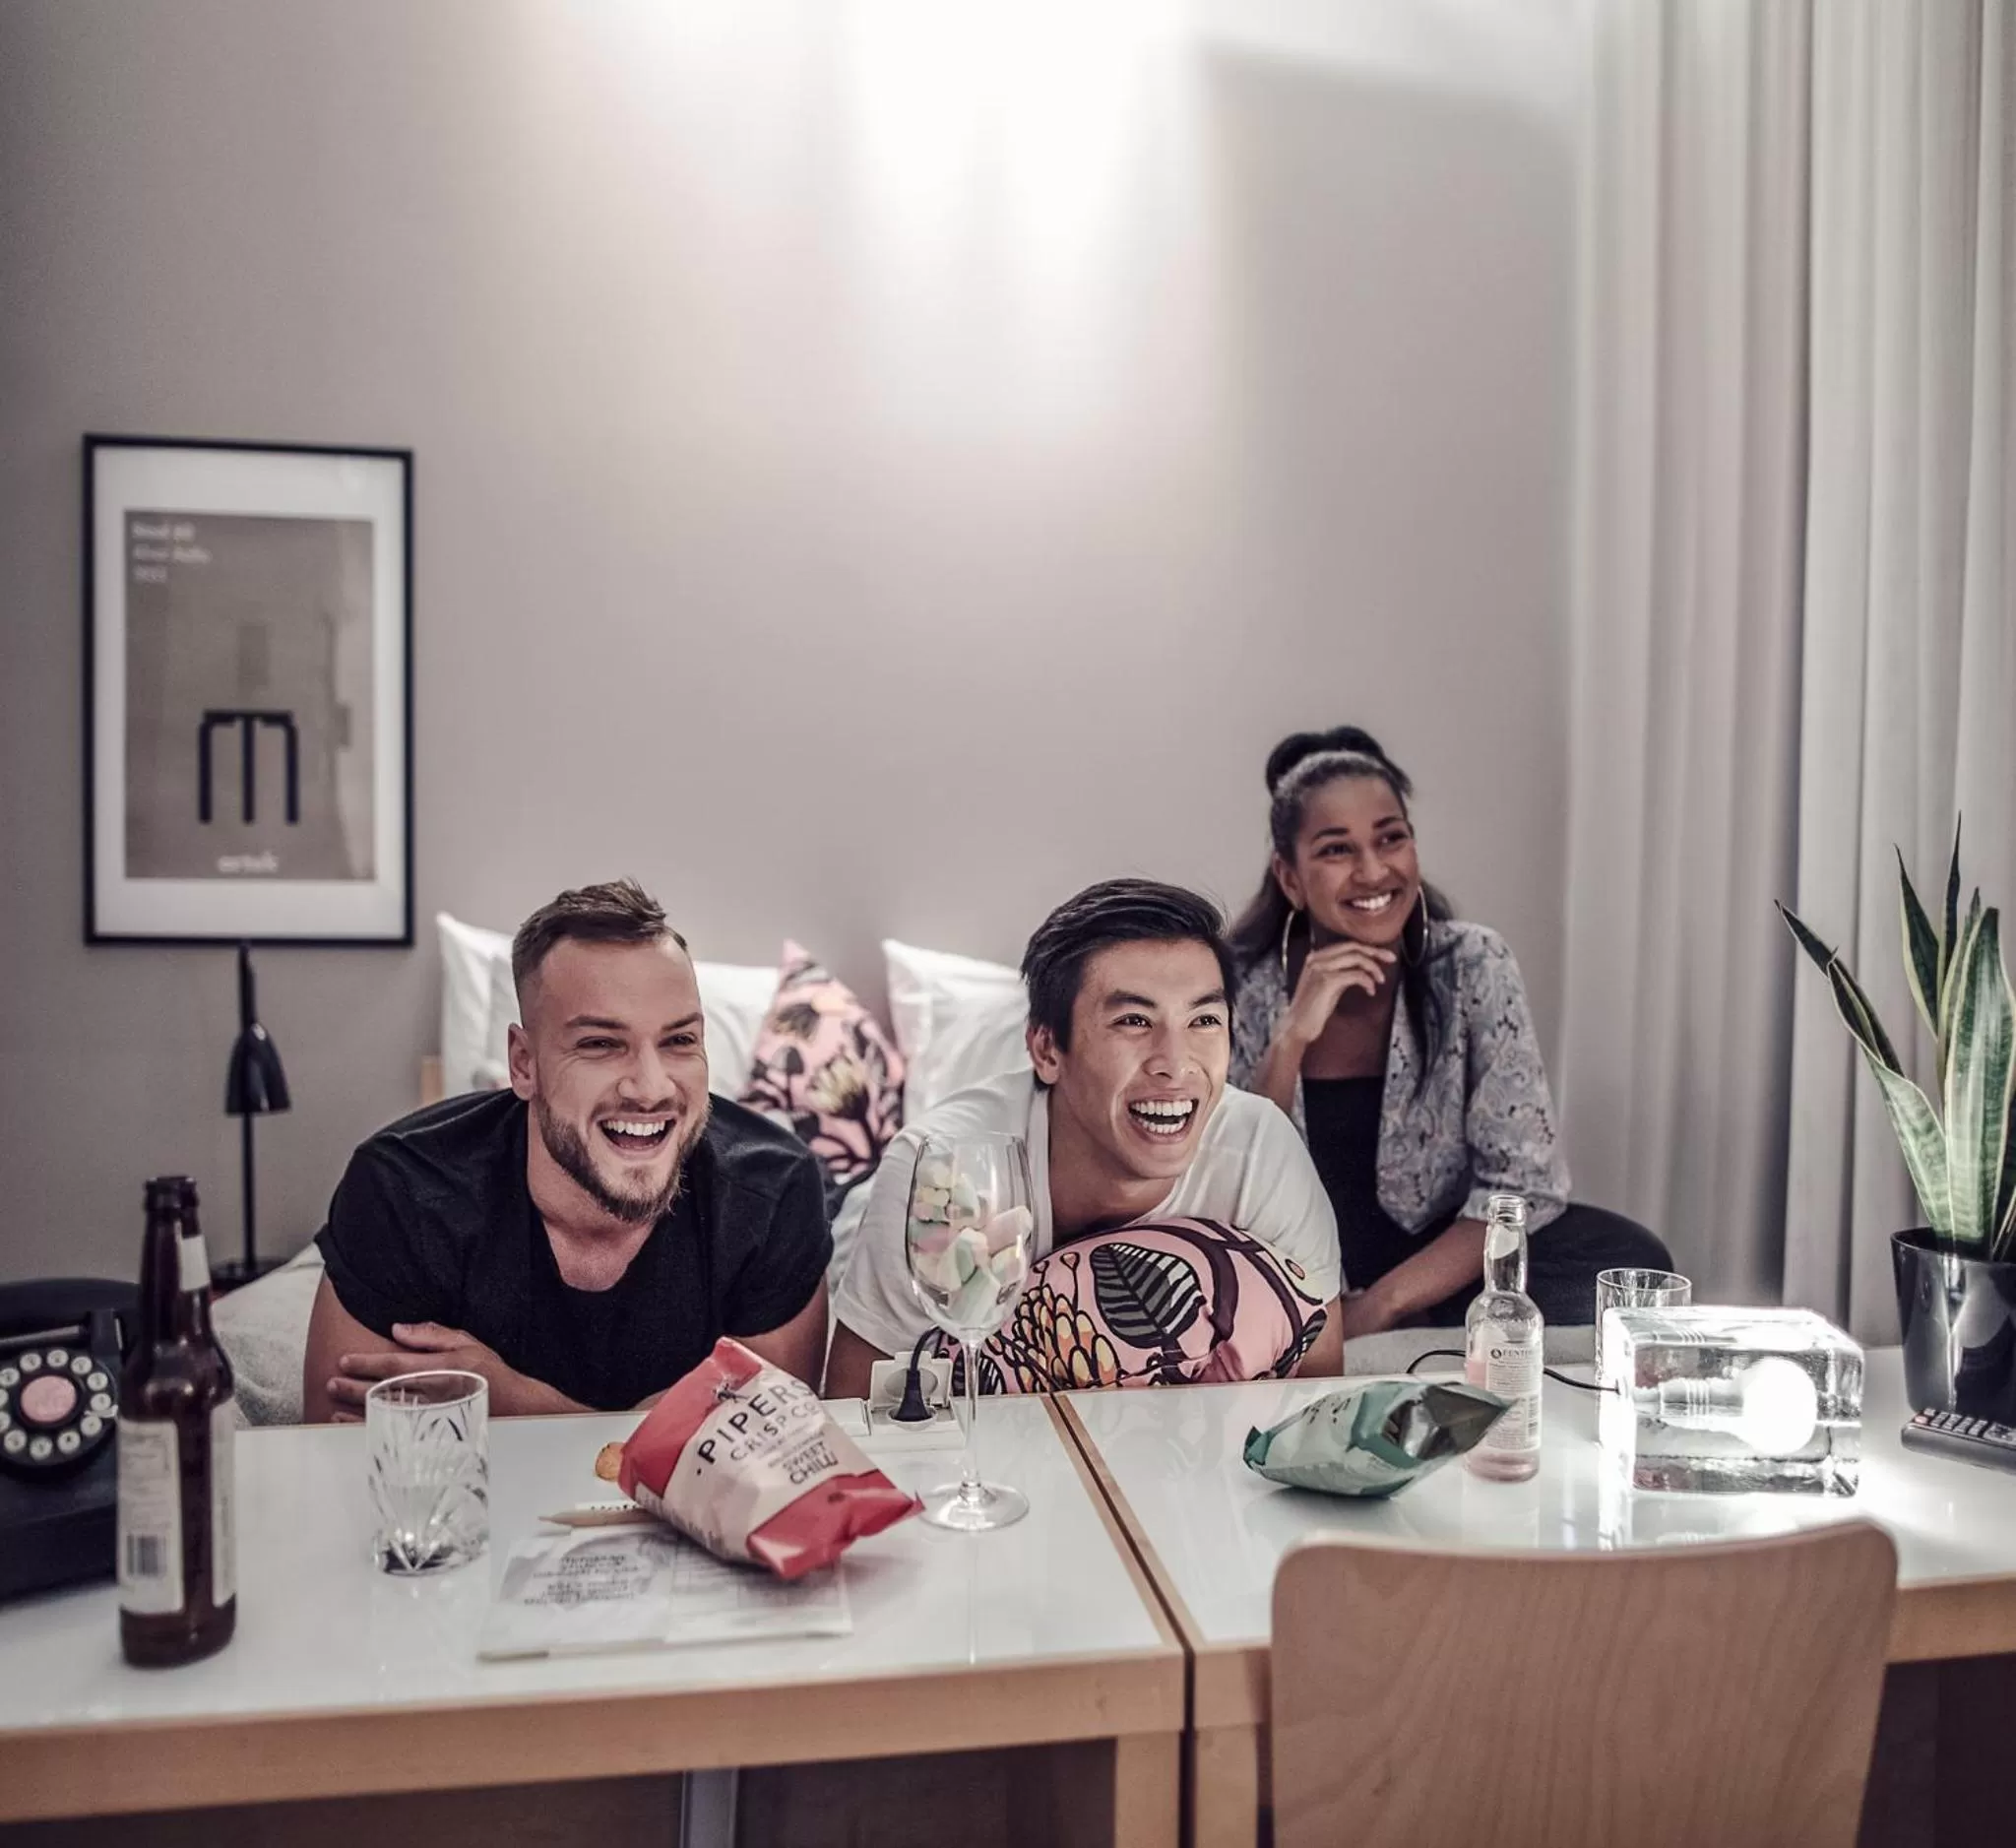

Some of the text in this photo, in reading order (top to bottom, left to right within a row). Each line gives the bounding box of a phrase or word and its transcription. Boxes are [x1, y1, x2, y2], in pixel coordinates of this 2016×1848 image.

[697, 1379, 814, 1466] PIPERS
[730, 1415, 788, 1462] CRISP
[783, 1440, 826, 1472] SWEET
